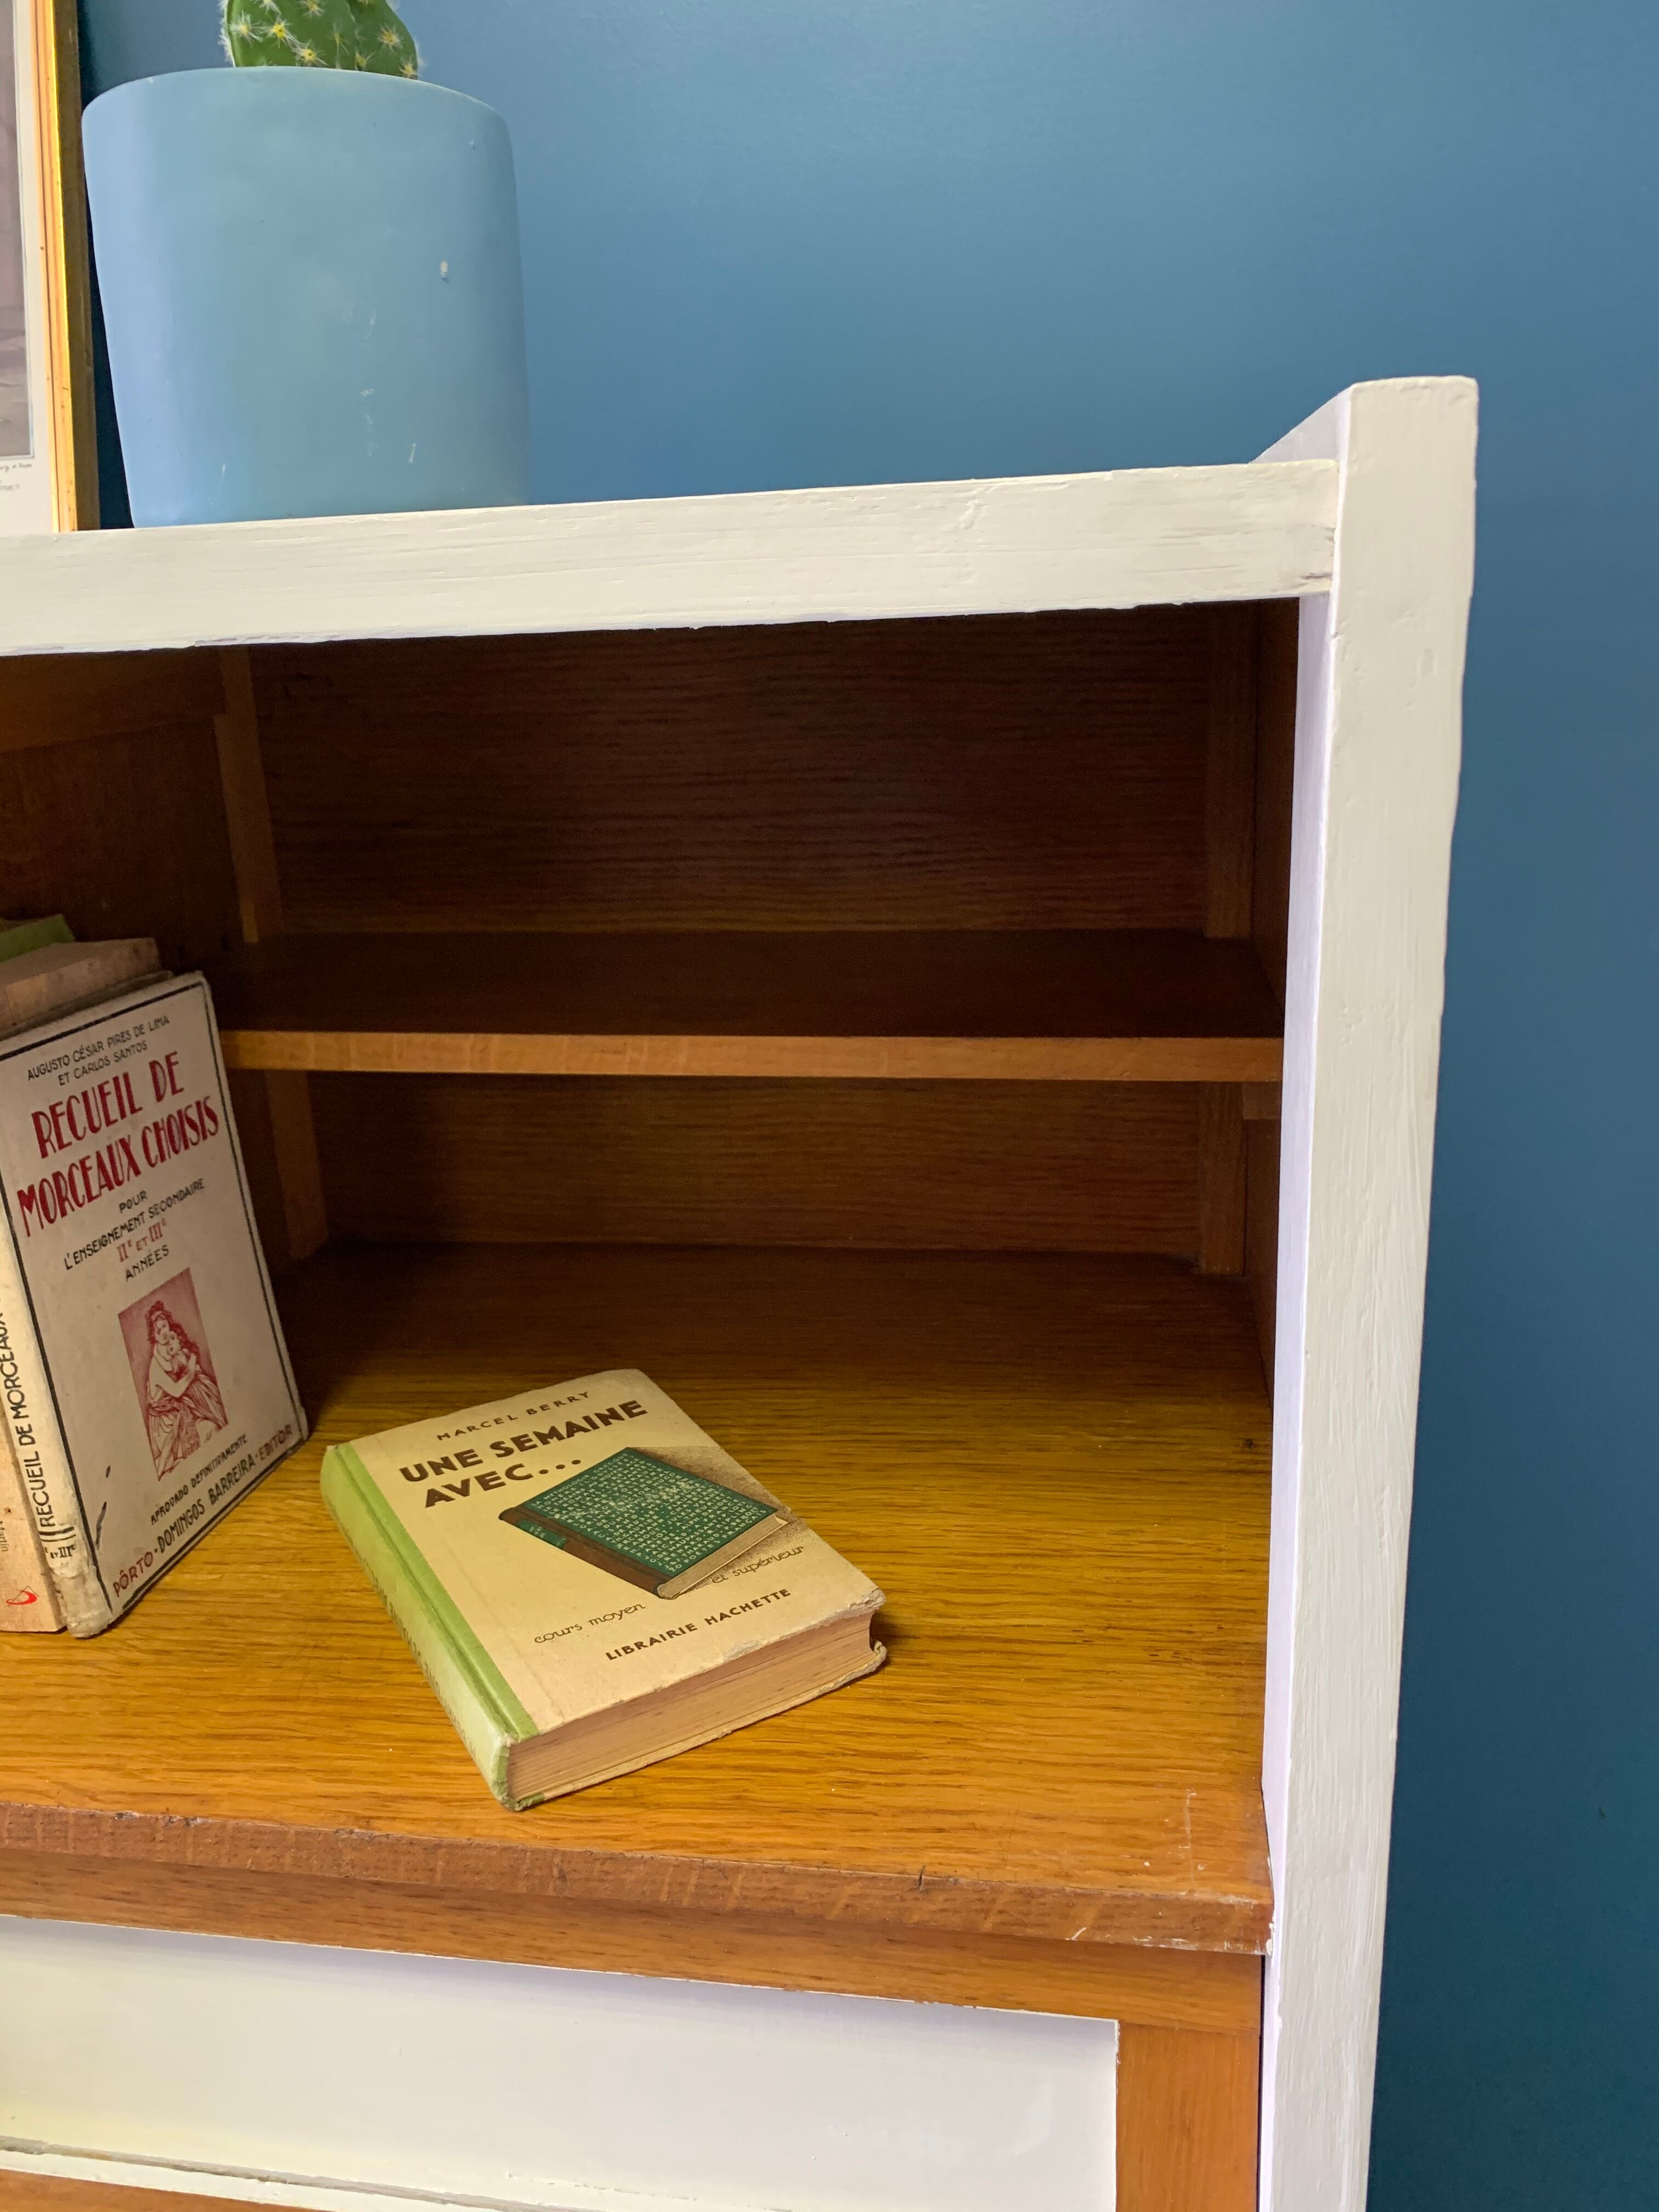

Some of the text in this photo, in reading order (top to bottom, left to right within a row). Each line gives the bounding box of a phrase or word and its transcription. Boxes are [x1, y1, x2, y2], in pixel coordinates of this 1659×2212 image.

[27, 1015, 170, 1081] AUGUSTO CÉSAR PIRES DE LIMA
[58, 1040, 148, 1087] ET CARLOS SANTOS
[31, 1051, 184, 1159] RECUEIL DE
[16, 1096, 219, 1238] MORCEAUX CHOISIS
[119, 1190, 147, 1214] POUR
[64, 1178, 205, 1271] L'ENSEIGNEMENT SECONDAIRE
[136, 1236, 148, 1251] ET
[125, 1244, 170, 1282] ANNÉES
[15, 1423, 36, 1446] DE
[399, 1400, 648, 1482] UNE SEMAINE
[437, 1391, 590, 1441] MARCEL BERRY
[24, 1451, 56, 1527] RECUEIL
[112, 1424, 294, 1597] PÔRTO DOMINGOS BARREIRA EDITOR
[150, 1433, 247, 1526] APROVADO DEFINITIVAMENTE
[552, 1491, 602, 1518] ABELAIS
[562, 1488, 596, 1506] ROMAN
[534, 1544, 805, 1644] cours moyen et supérieur
[605, 1588, 791, 1662] LIBRAIRIE HACHETTE
